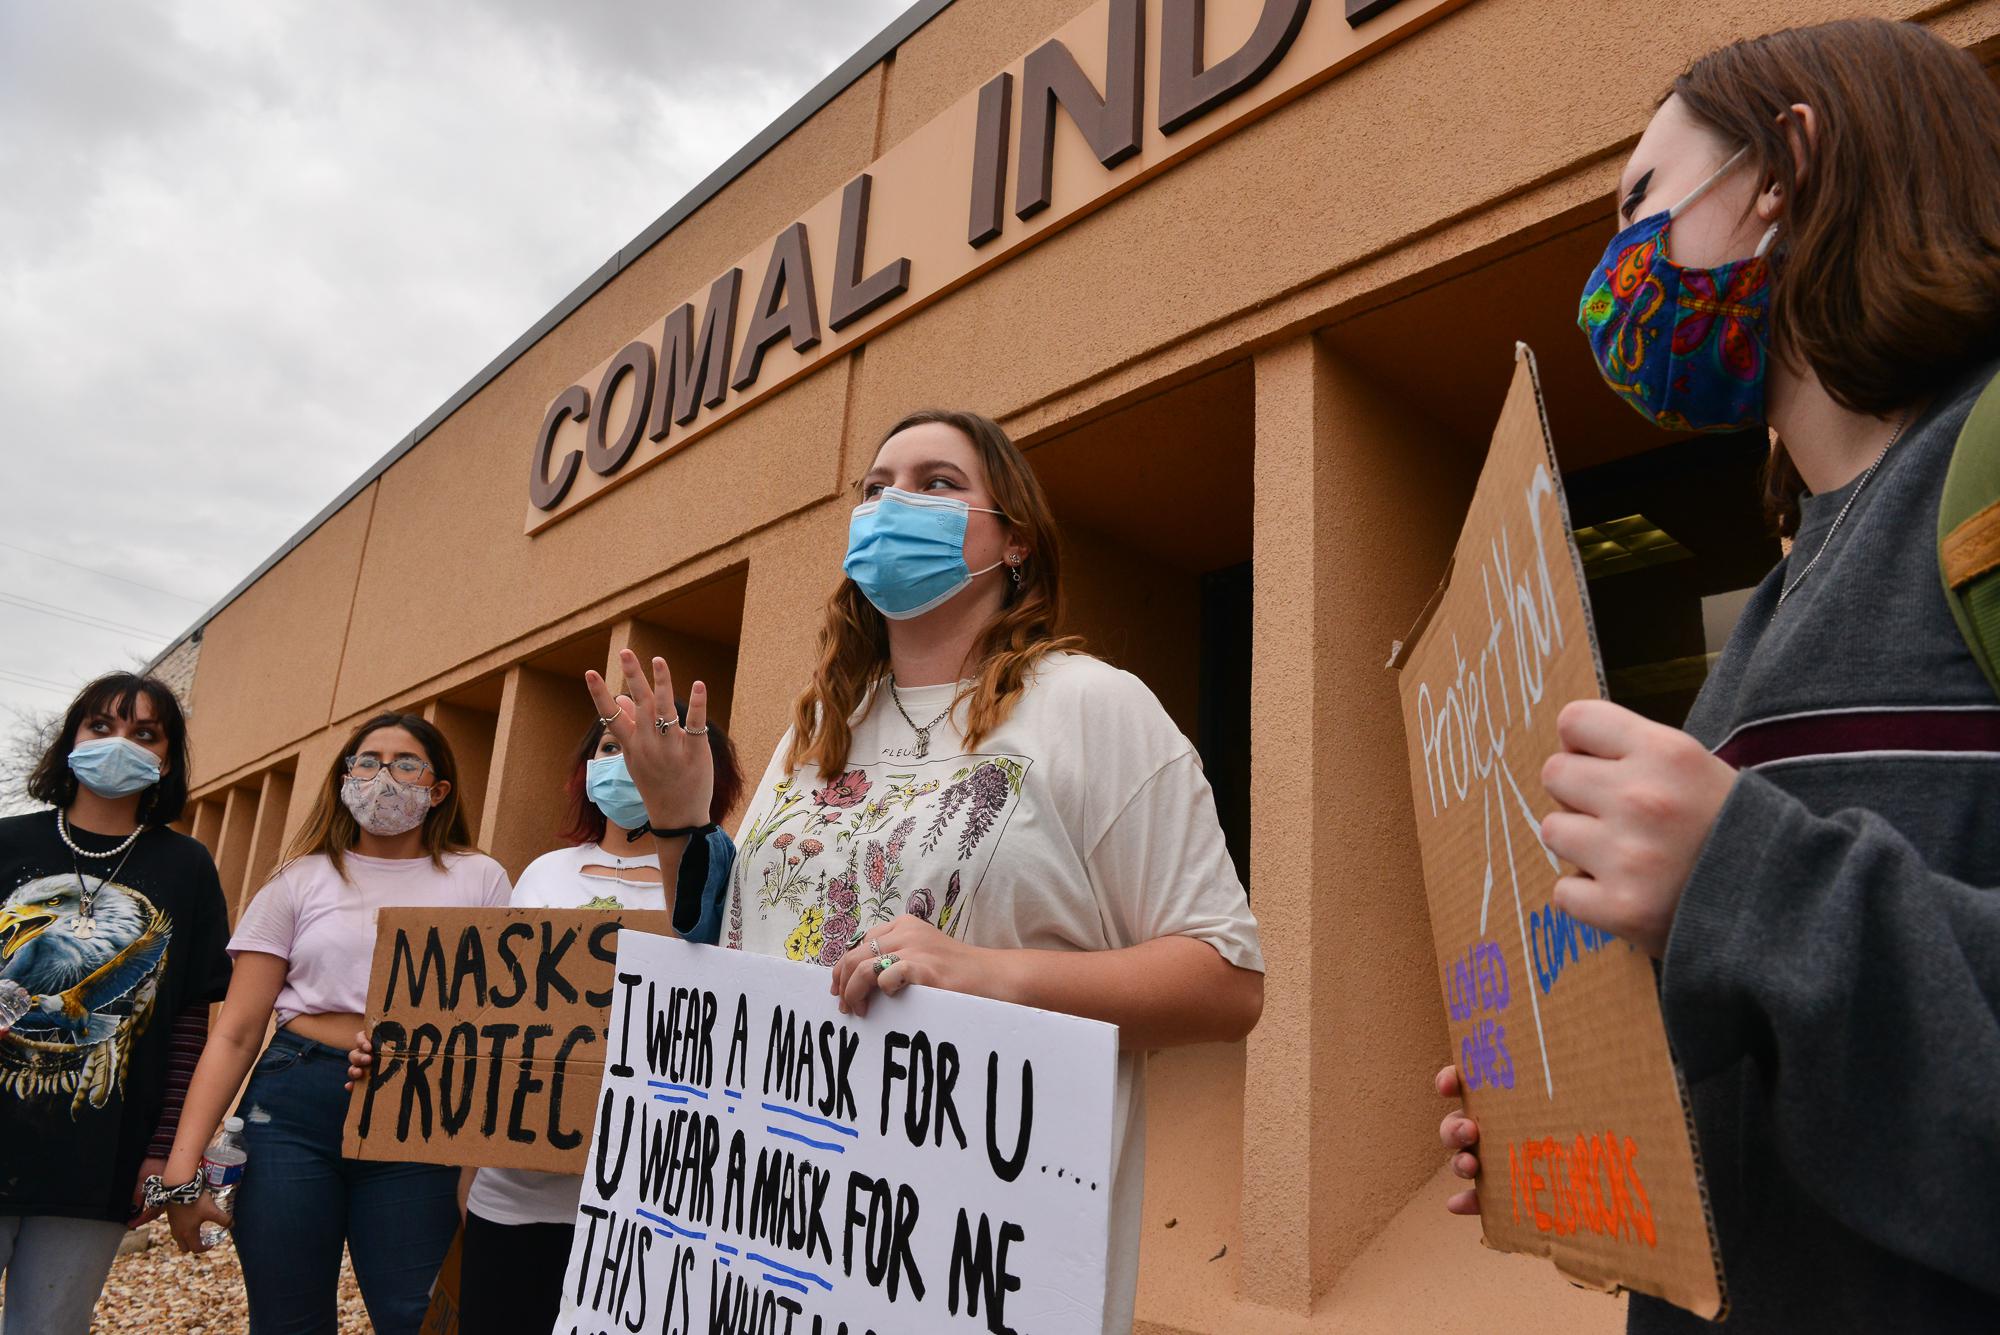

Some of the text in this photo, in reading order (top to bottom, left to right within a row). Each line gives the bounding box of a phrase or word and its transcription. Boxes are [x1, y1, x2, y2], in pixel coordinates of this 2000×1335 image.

[528, 0, 1408, 513] COMAL IND
[383, 918, 623, 1013] MASKS
[1446, 941, 1511, 1021] LOVED
[358, 1021, 609, 1150] PROTEC
[610, 972, 642, 1078] I
[646, 980, 717, 1088] WEAR
[726, 992, 748, 1090] A
[763, 1004, 860, 1121] MASK
[880, 1030, 968, 1150] FOR
[576, 1203, 652, 1333] THIS
[661, 1243, 695, 1335] IS
[595, 1088, 1025, 1335] U WEAR A MASK FOR ME
